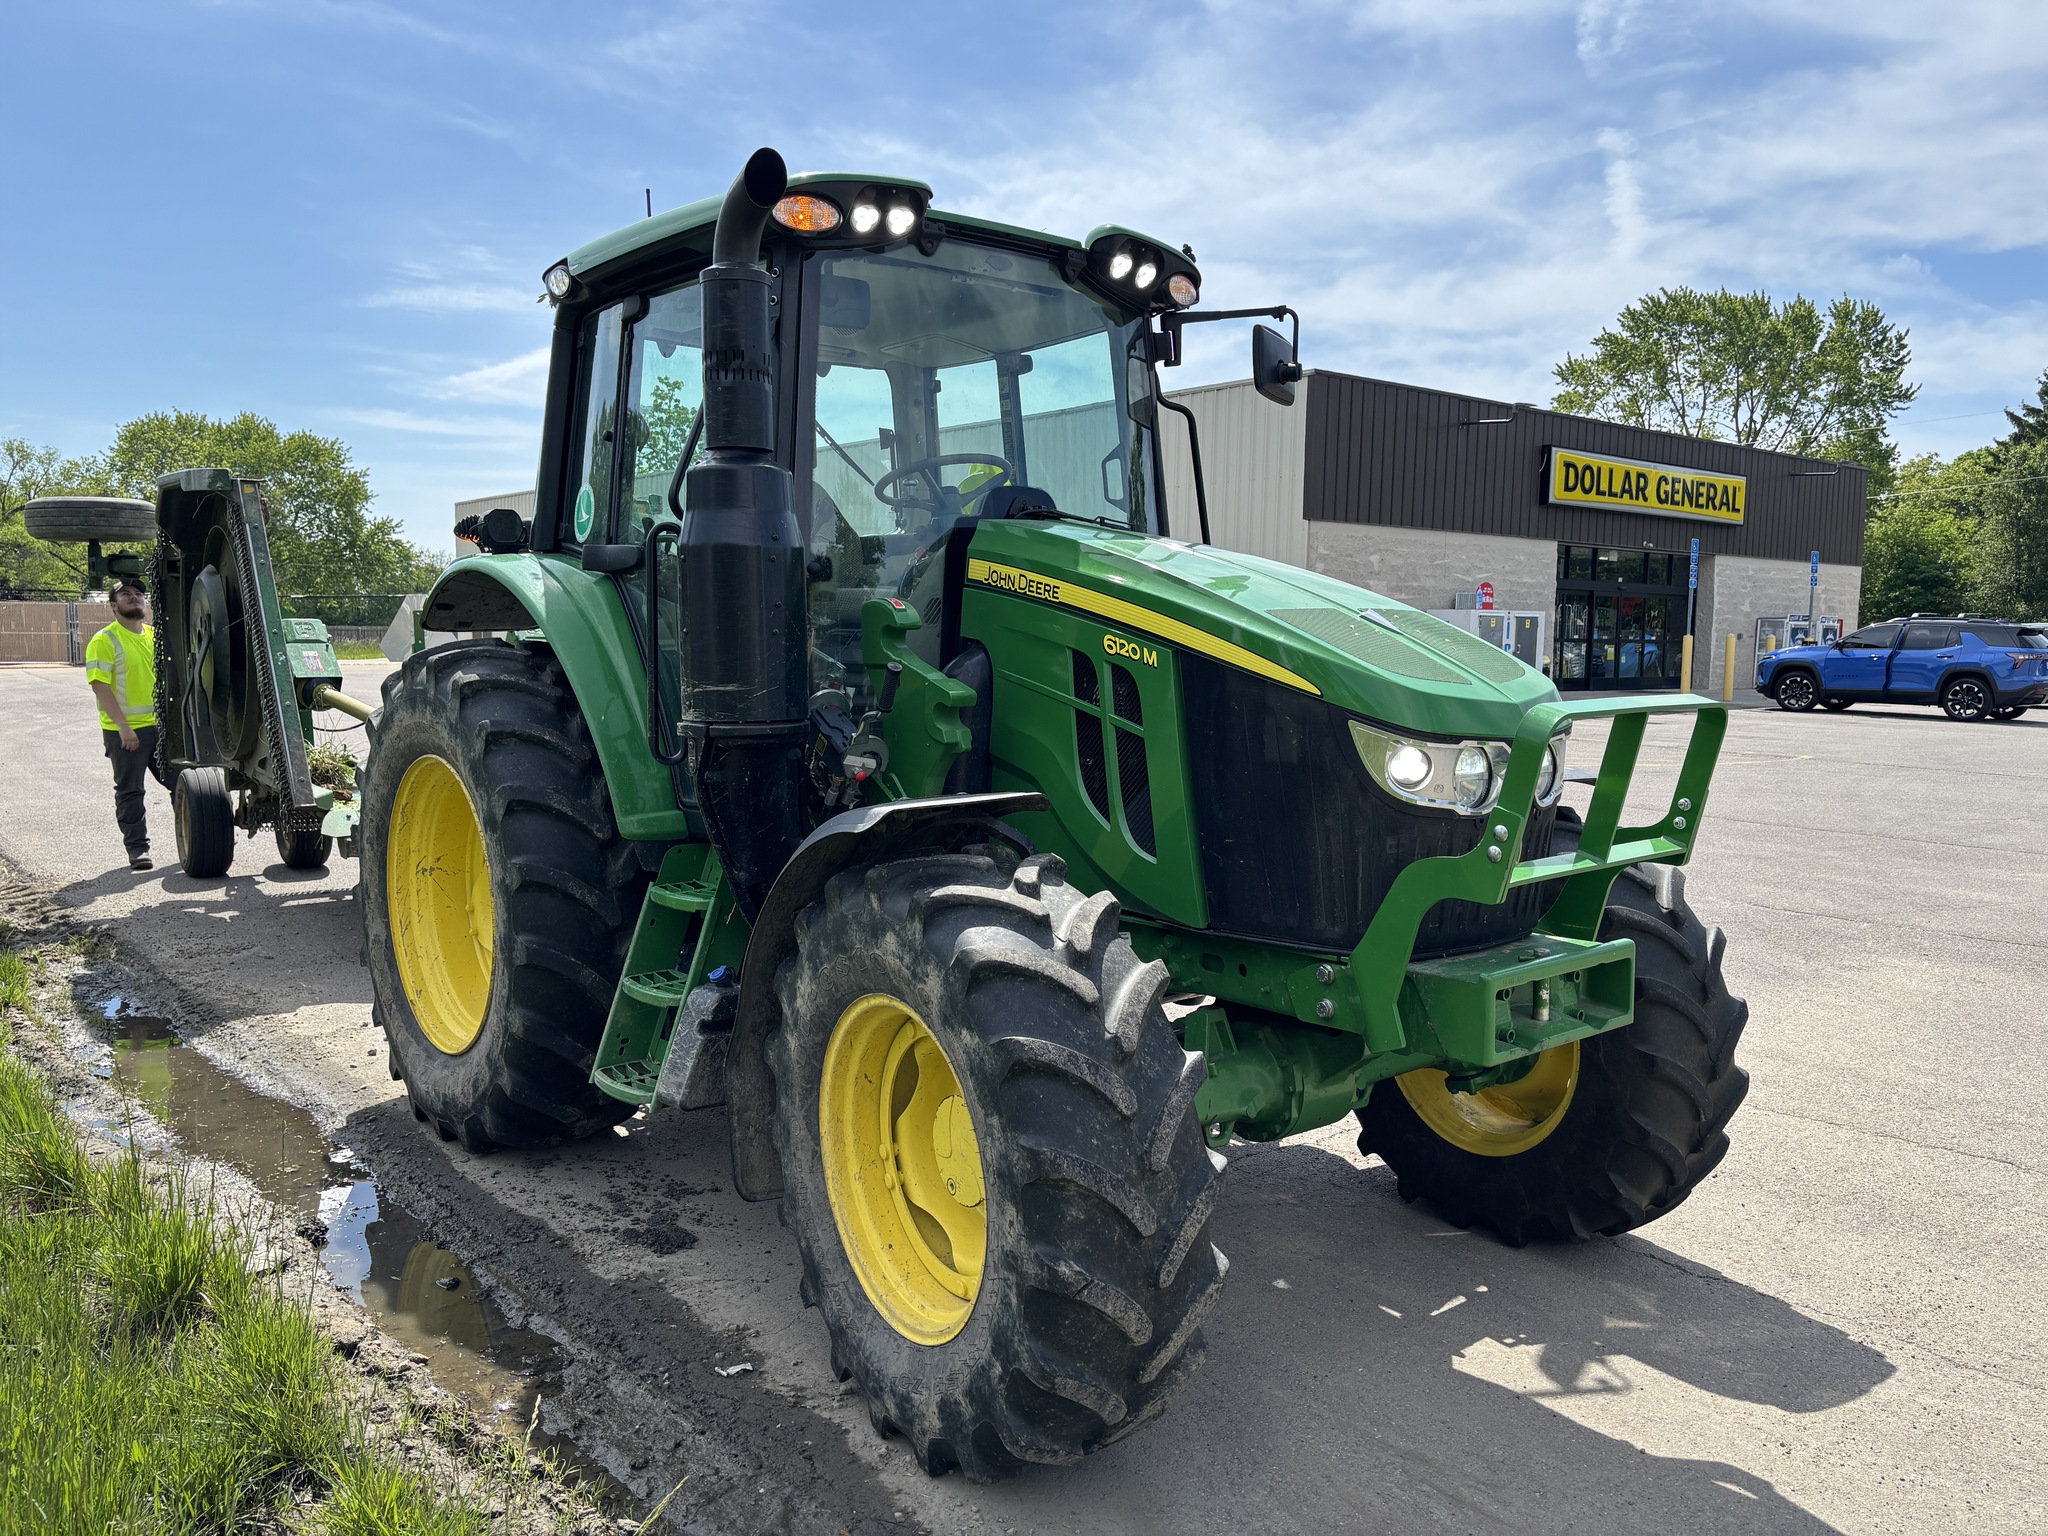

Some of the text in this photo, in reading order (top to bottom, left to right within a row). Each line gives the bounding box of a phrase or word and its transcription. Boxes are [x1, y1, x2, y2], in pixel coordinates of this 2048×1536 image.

[1563, 460, 1741, 514] DOLLAR GENERAL
[983, 565, 1061, 601] JOHN DEERE
[1103, 634, 1158, 669] 6120 M
